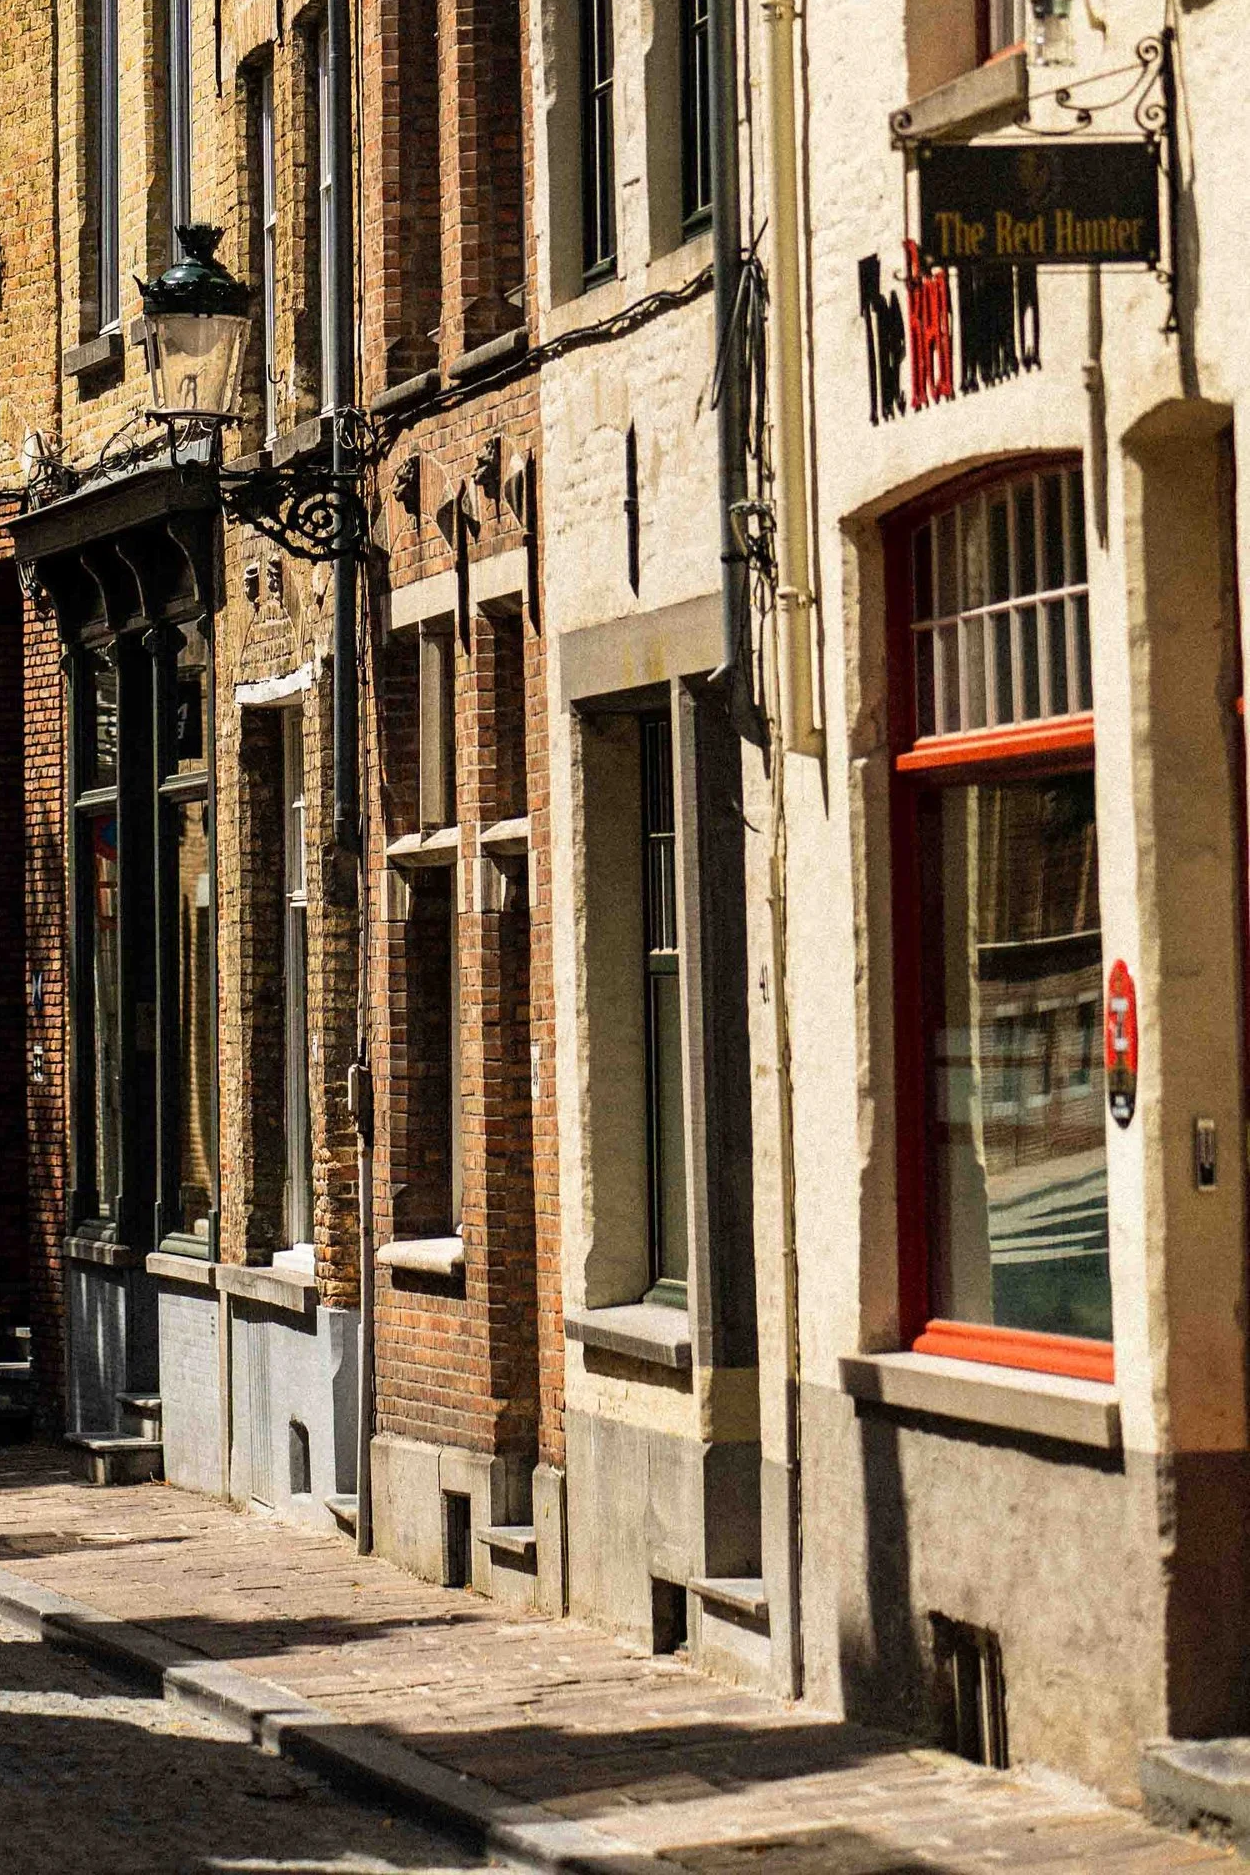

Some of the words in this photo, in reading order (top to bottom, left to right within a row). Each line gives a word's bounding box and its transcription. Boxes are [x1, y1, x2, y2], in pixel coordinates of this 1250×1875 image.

[934, 211, 986, 257] The
[995, 209, 1046, 255] Red
[1054, 208, 1144, 254] Hunter
